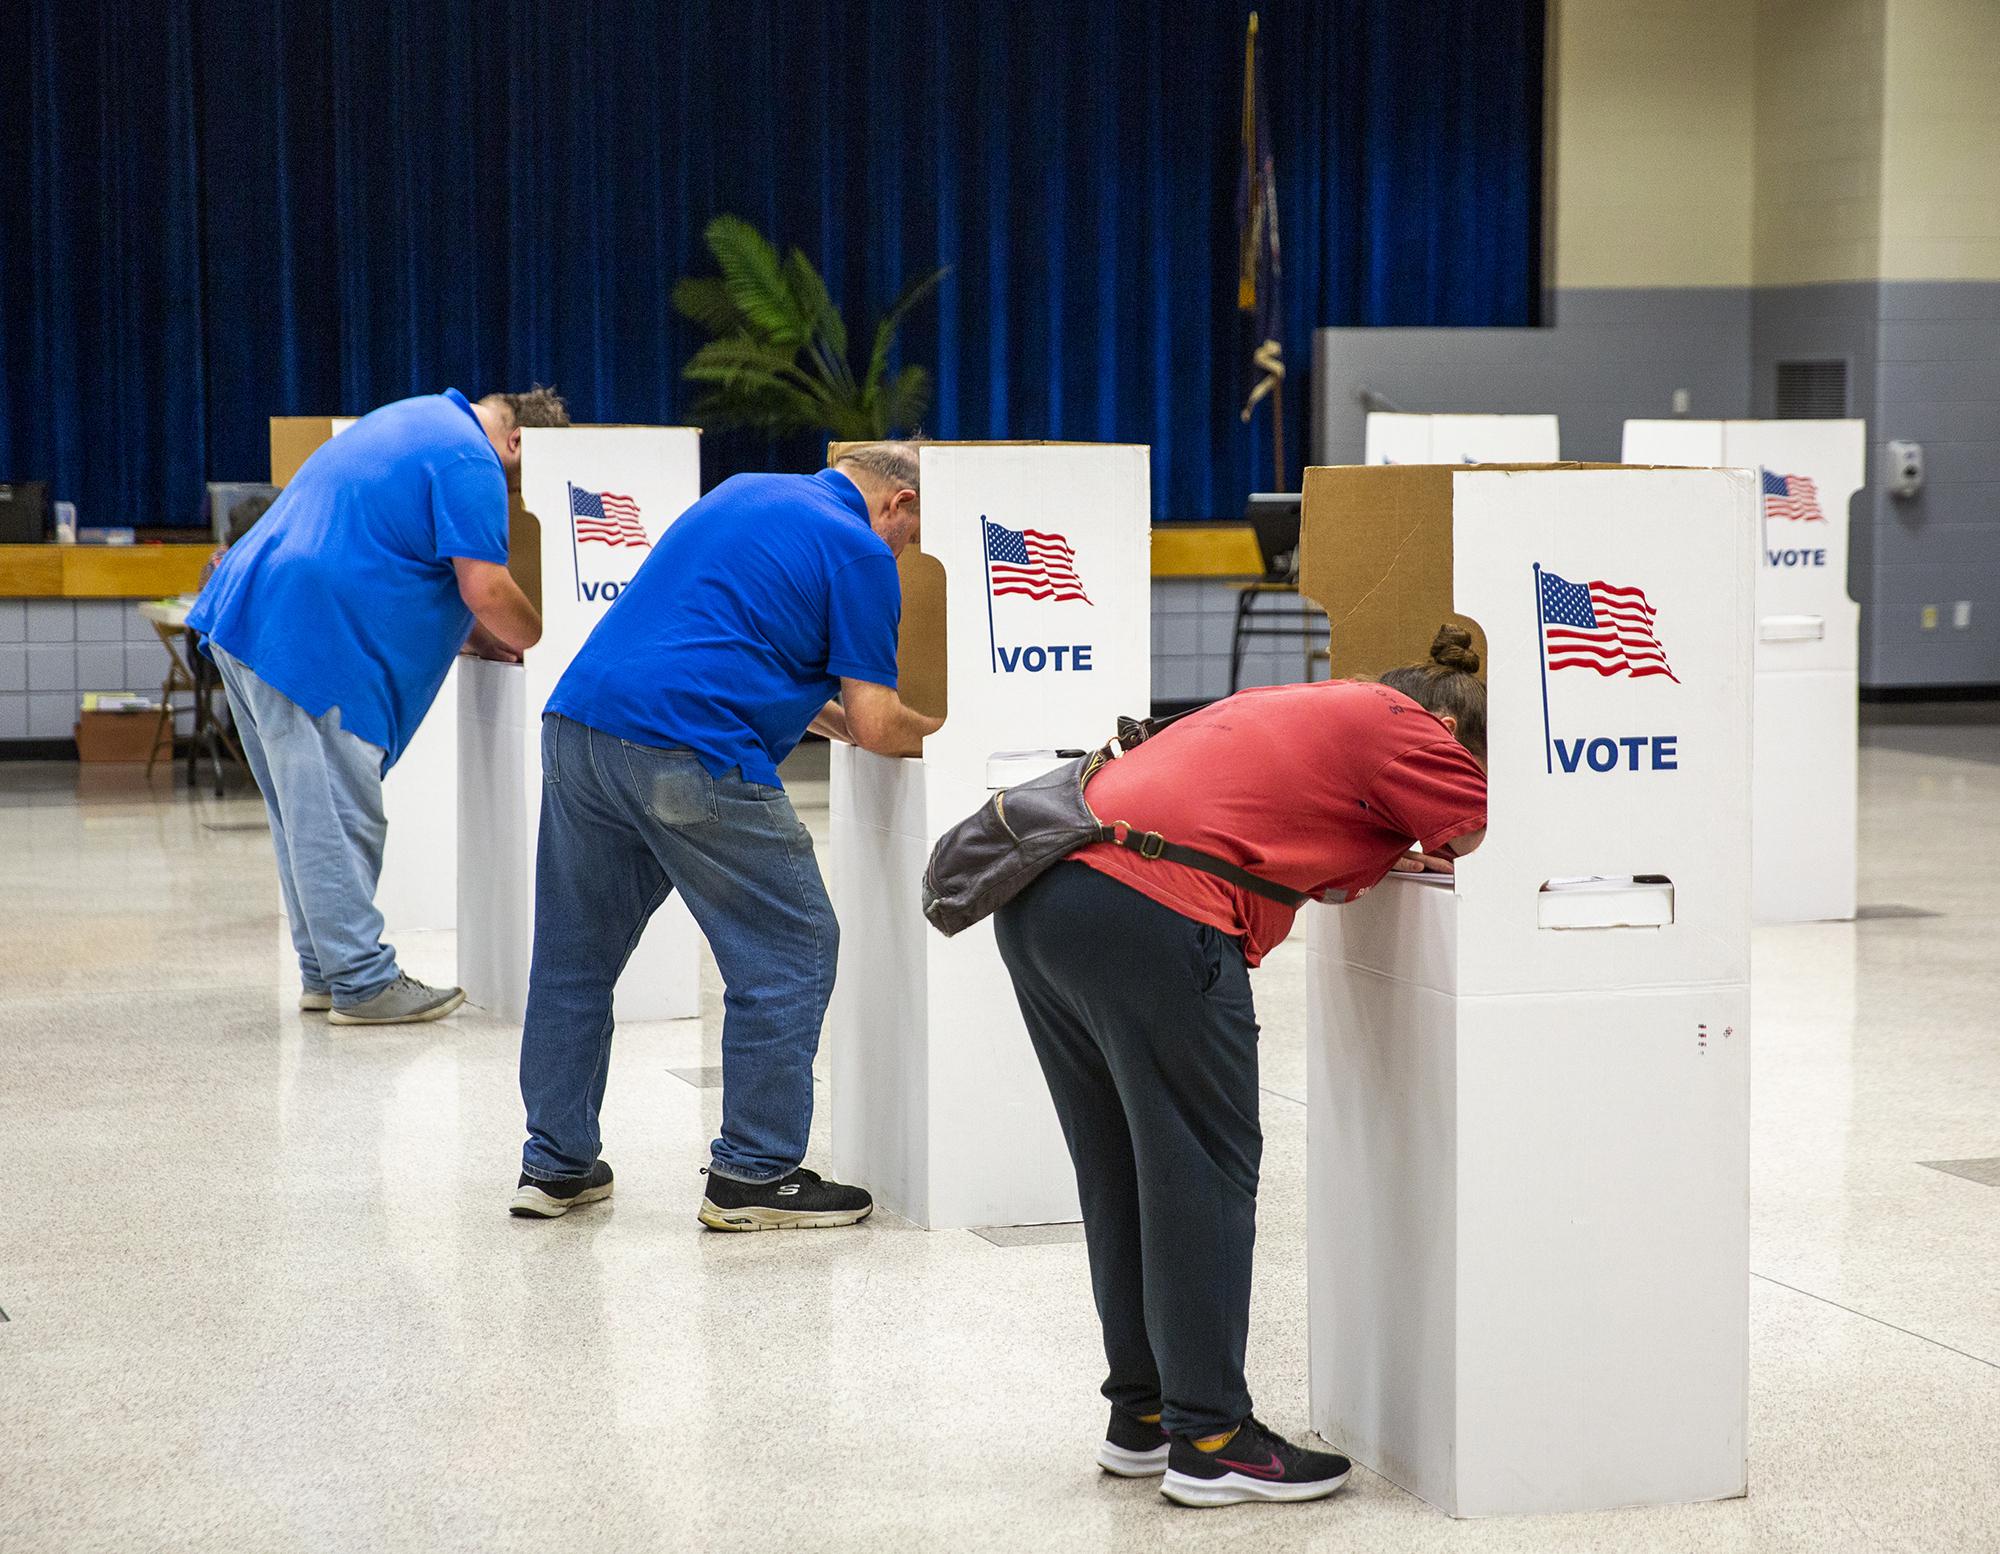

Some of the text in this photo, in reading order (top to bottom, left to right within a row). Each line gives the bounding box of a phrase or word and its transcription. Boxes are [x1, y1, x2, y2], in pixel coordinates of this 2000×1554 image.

[1768, 549, 1825, 566] VOTE
[997, 645, 1092, 672] VOTE
[1553, 736, 1678, 773] VOTE
